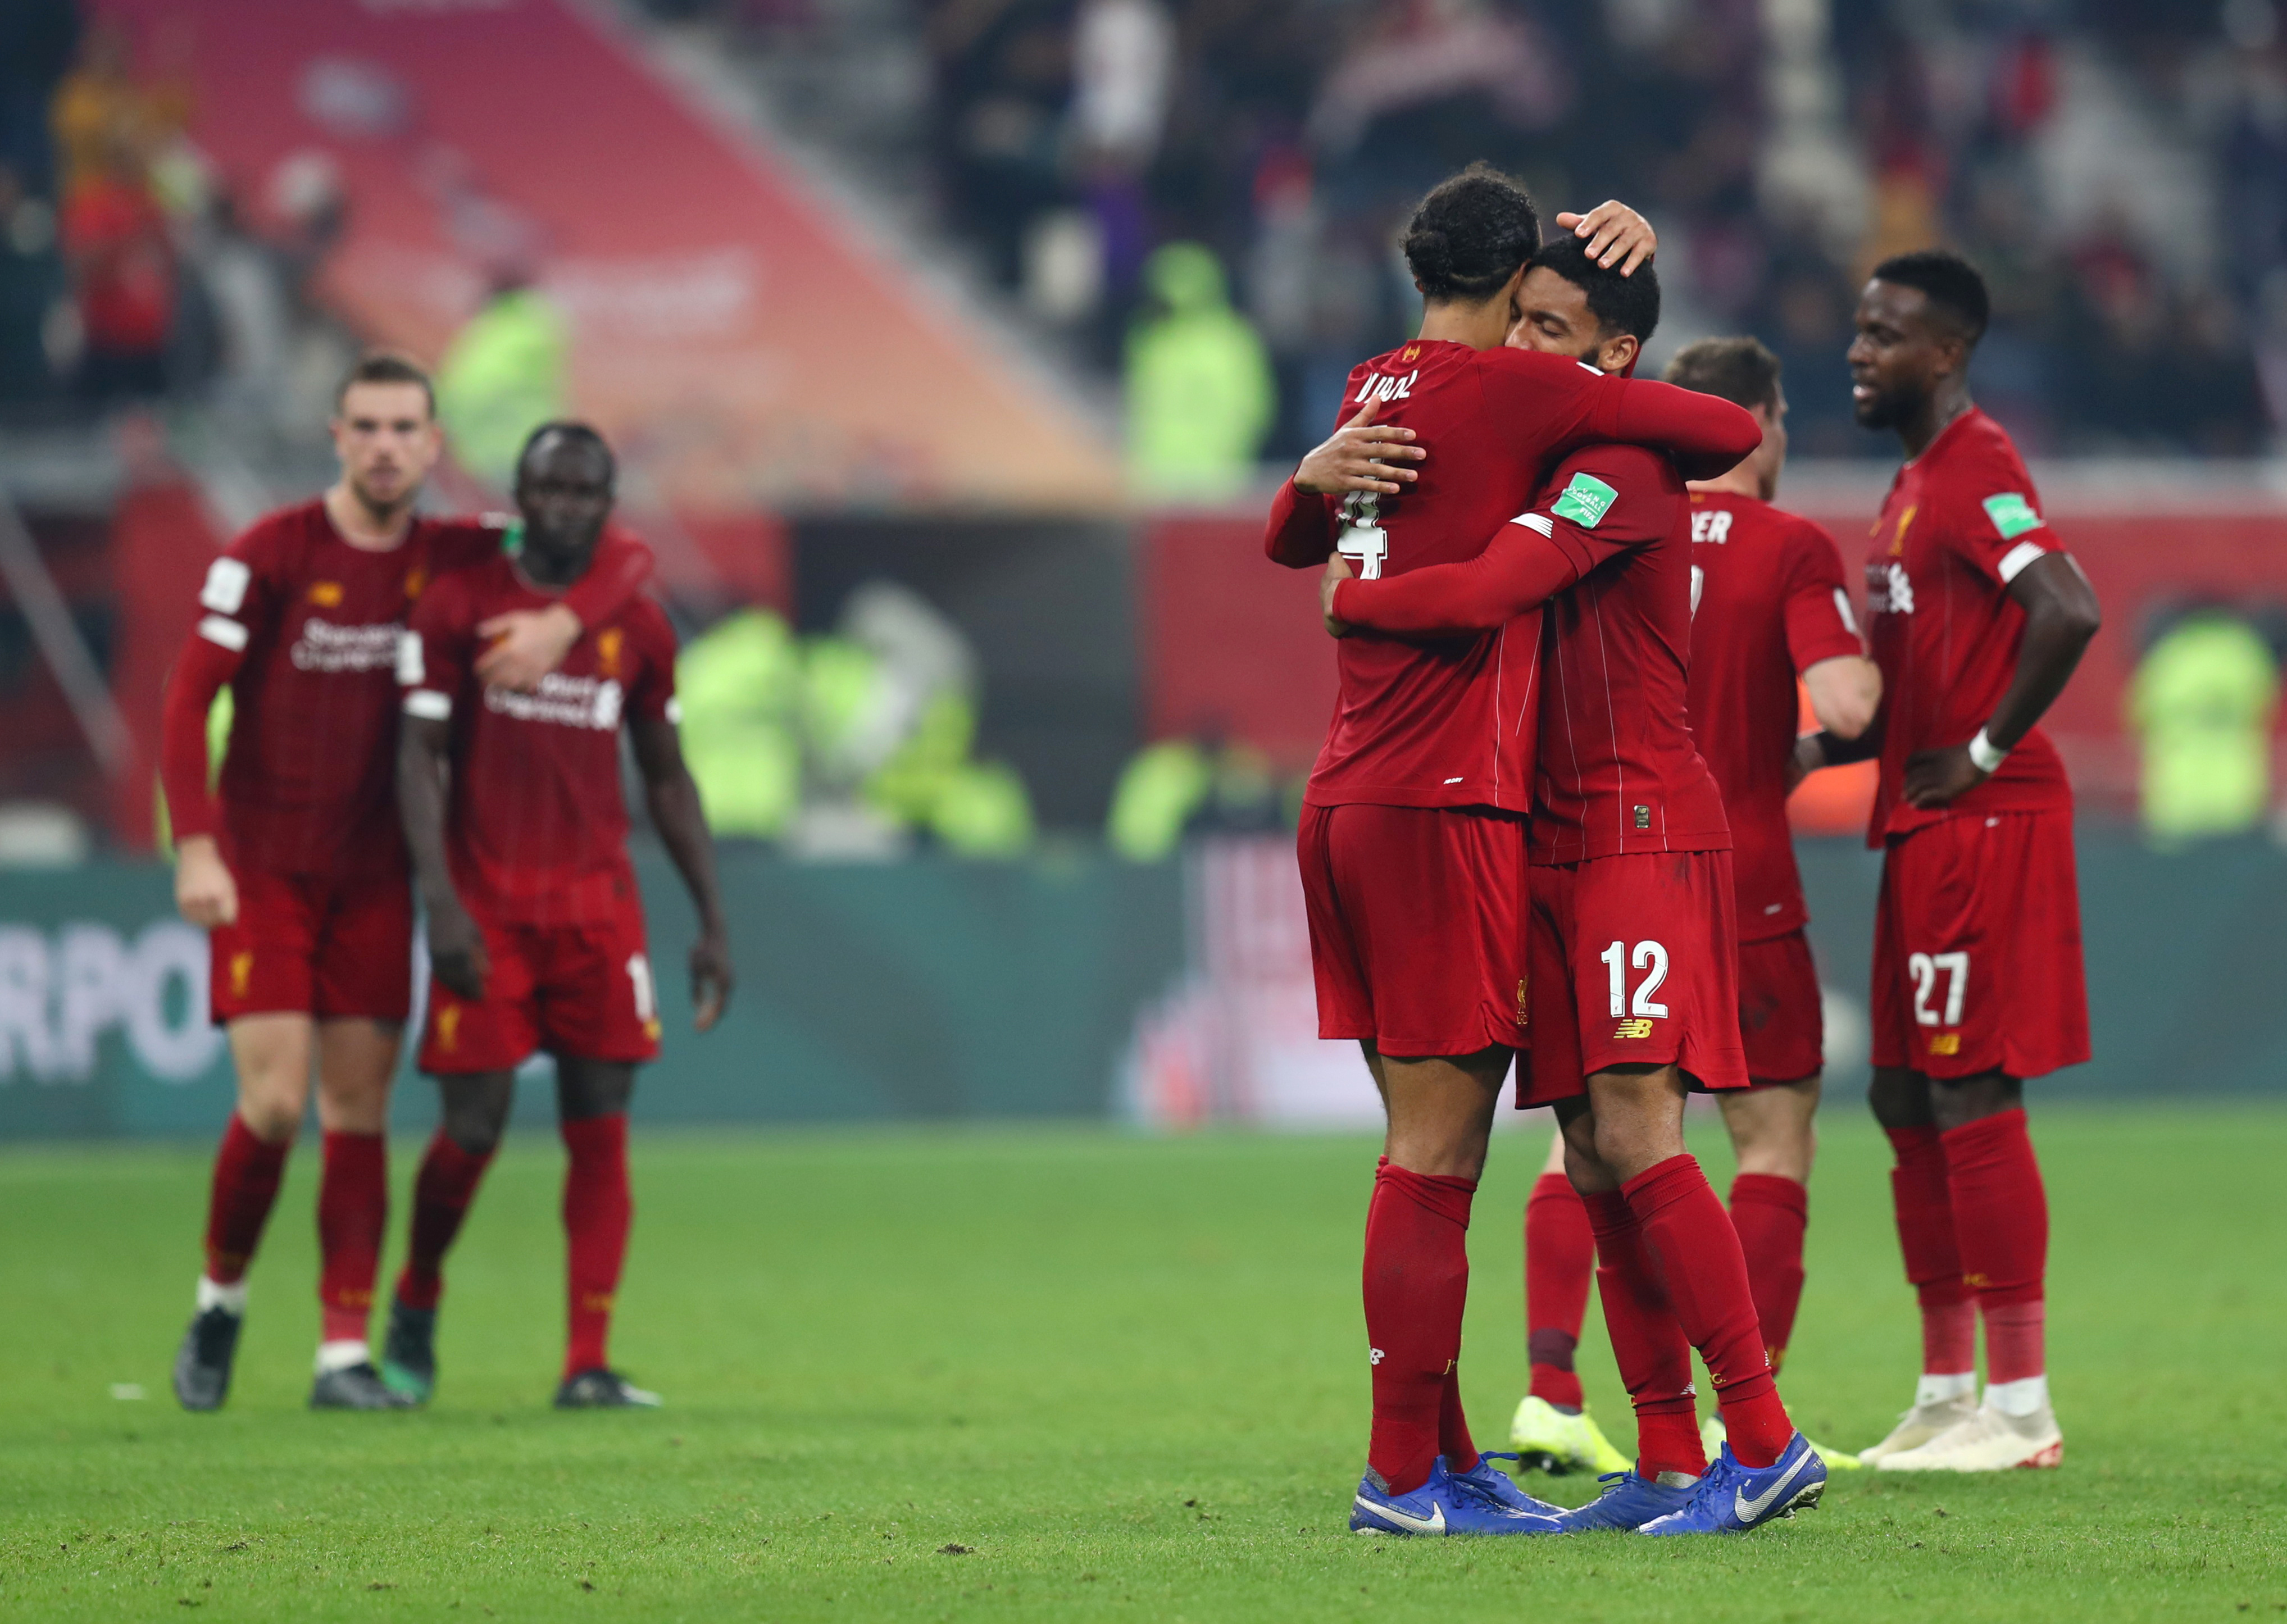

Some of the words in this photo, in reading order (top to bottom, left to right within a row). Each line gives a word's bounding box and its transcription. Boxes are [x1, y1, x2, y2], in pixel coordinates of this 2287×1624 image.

[1579, 507, 1596, 522] FIFA
[1692, 511, 1733, 544] ER
[1601, 940, 1668, 1018] 12
[1909, 952, 1970, 1027] 27
[1613, 1019, 1653, 1039] NB
